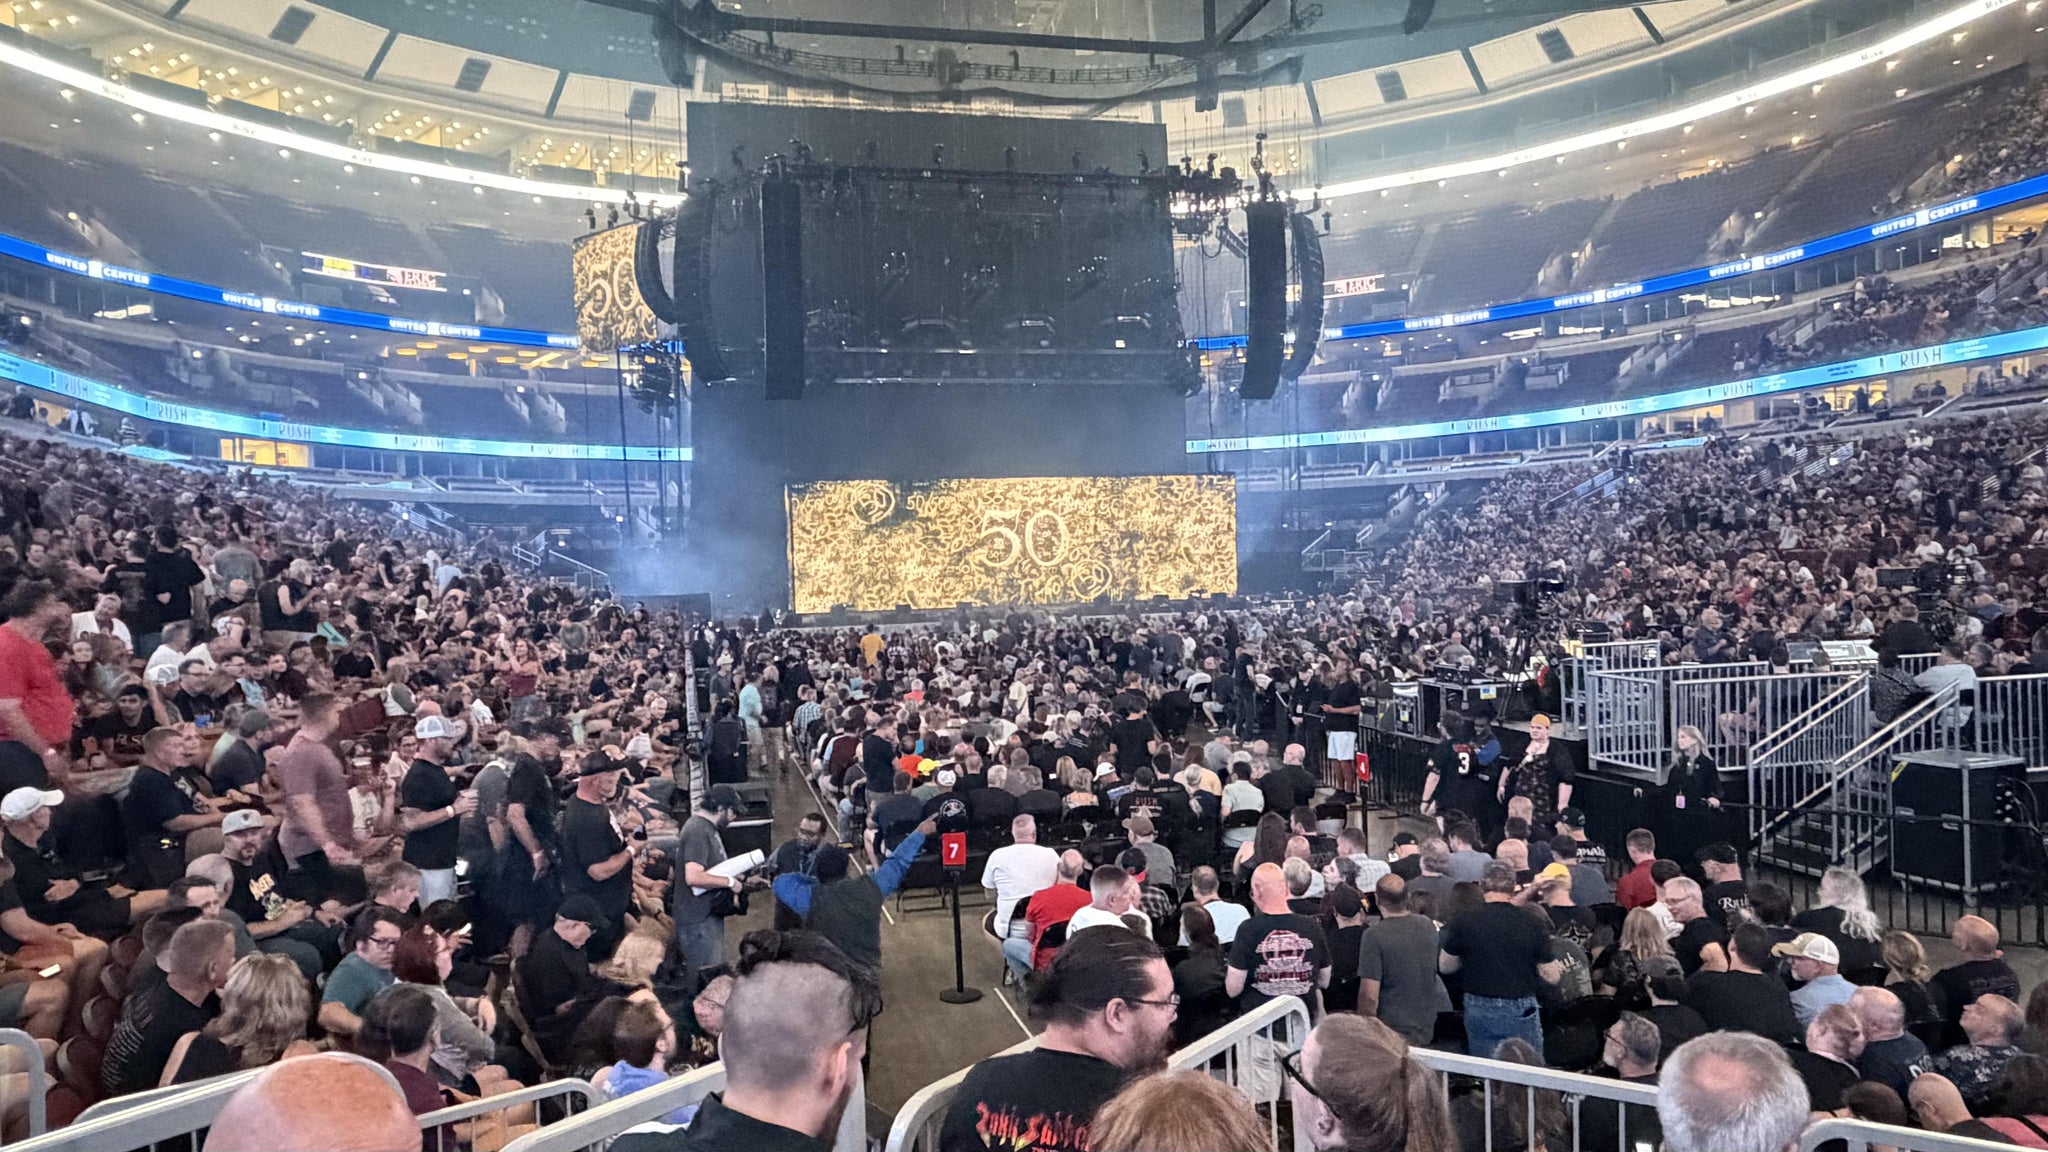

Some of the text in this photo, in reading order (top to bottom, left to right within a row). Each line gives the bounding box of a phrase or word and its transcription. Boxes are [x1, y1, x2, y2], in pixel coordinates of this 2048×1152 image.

[1871, 198, 1978, 236] UNITED CENTER
[46, 252, 150, 285] UNITED CENTER
[1709, 248, 1804, 278] UNITED CENTER
[582, 256, 641, 319] 50
[1554, 284, 1643, 308] UNITED CENTER
[222, 292, 320, 317] UNITED CENTER
[388, 319, 481, 337] UNITED CENTER
[1404, 311, 1490, 329] UNITED CENTER
[547, 335, 577, 348] UNITE
[1900, 346, 1942, 369] RUSH
[63, 375, 89, 396] RUSH
[1722, 380, 1754, 397] RUSH
[158, 404, 188, 421] RUSH
[1597, 401, 1629, 416] RUSH
[279, 422, 311, 440] RUSH
[1466, 418, 1498, 432] RUSH
[976, 504, 1070, 567] 50
[1360, 762, 1366, 774] 4
[1458, 752, 1470, 774] 3
[949, 843, 959, 859] 7
